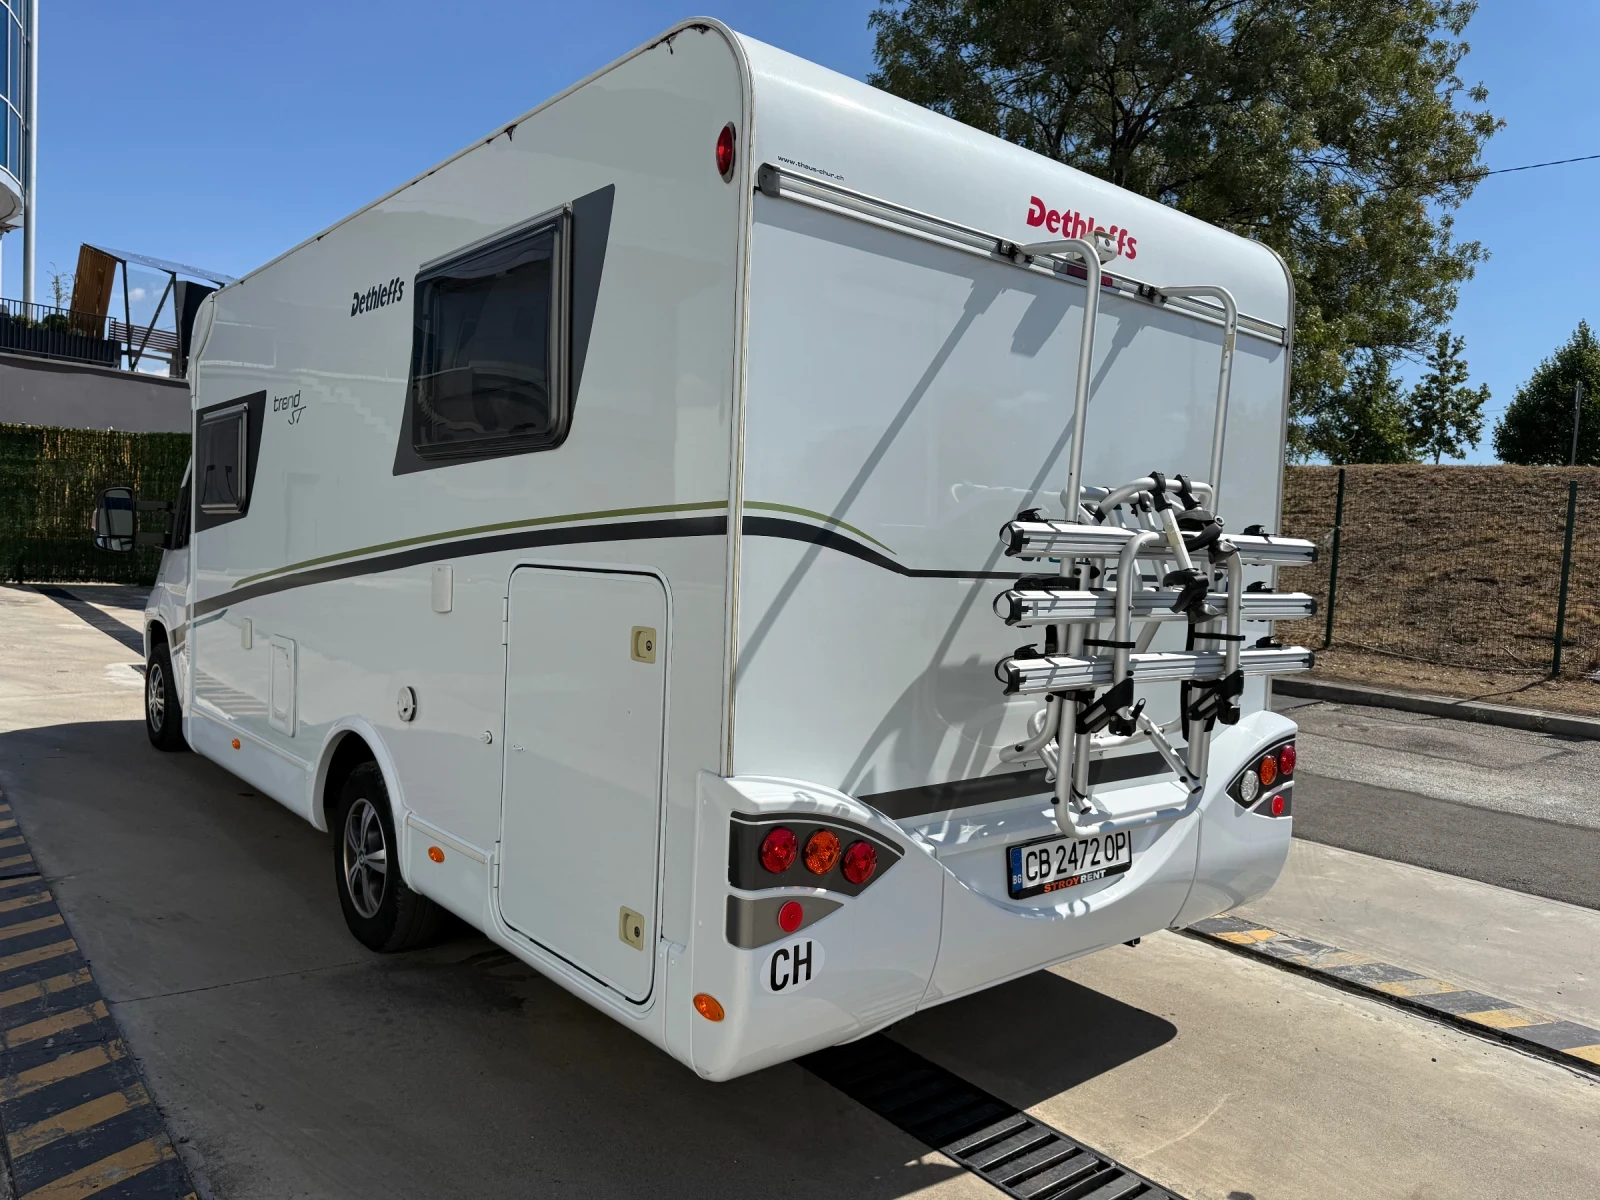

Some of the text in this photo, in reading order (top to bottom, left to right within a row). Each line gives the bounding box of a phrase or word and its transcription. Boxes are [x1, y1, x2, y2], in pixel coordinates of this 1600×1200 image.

[777, 156, 845, 181] www.theus-chur.ch
[1026, 195, 1137, 260] Dethlfs
[351, 277, 404, 317] Dethleffs
[273, 390, 301, 412] trend
[288, 405, 307, 425] ST
[1025, 832, 1126, 882] CB 2472 OP
[1012, 873, 1023, 885] BG
[770, 941, 812, 992] CH
